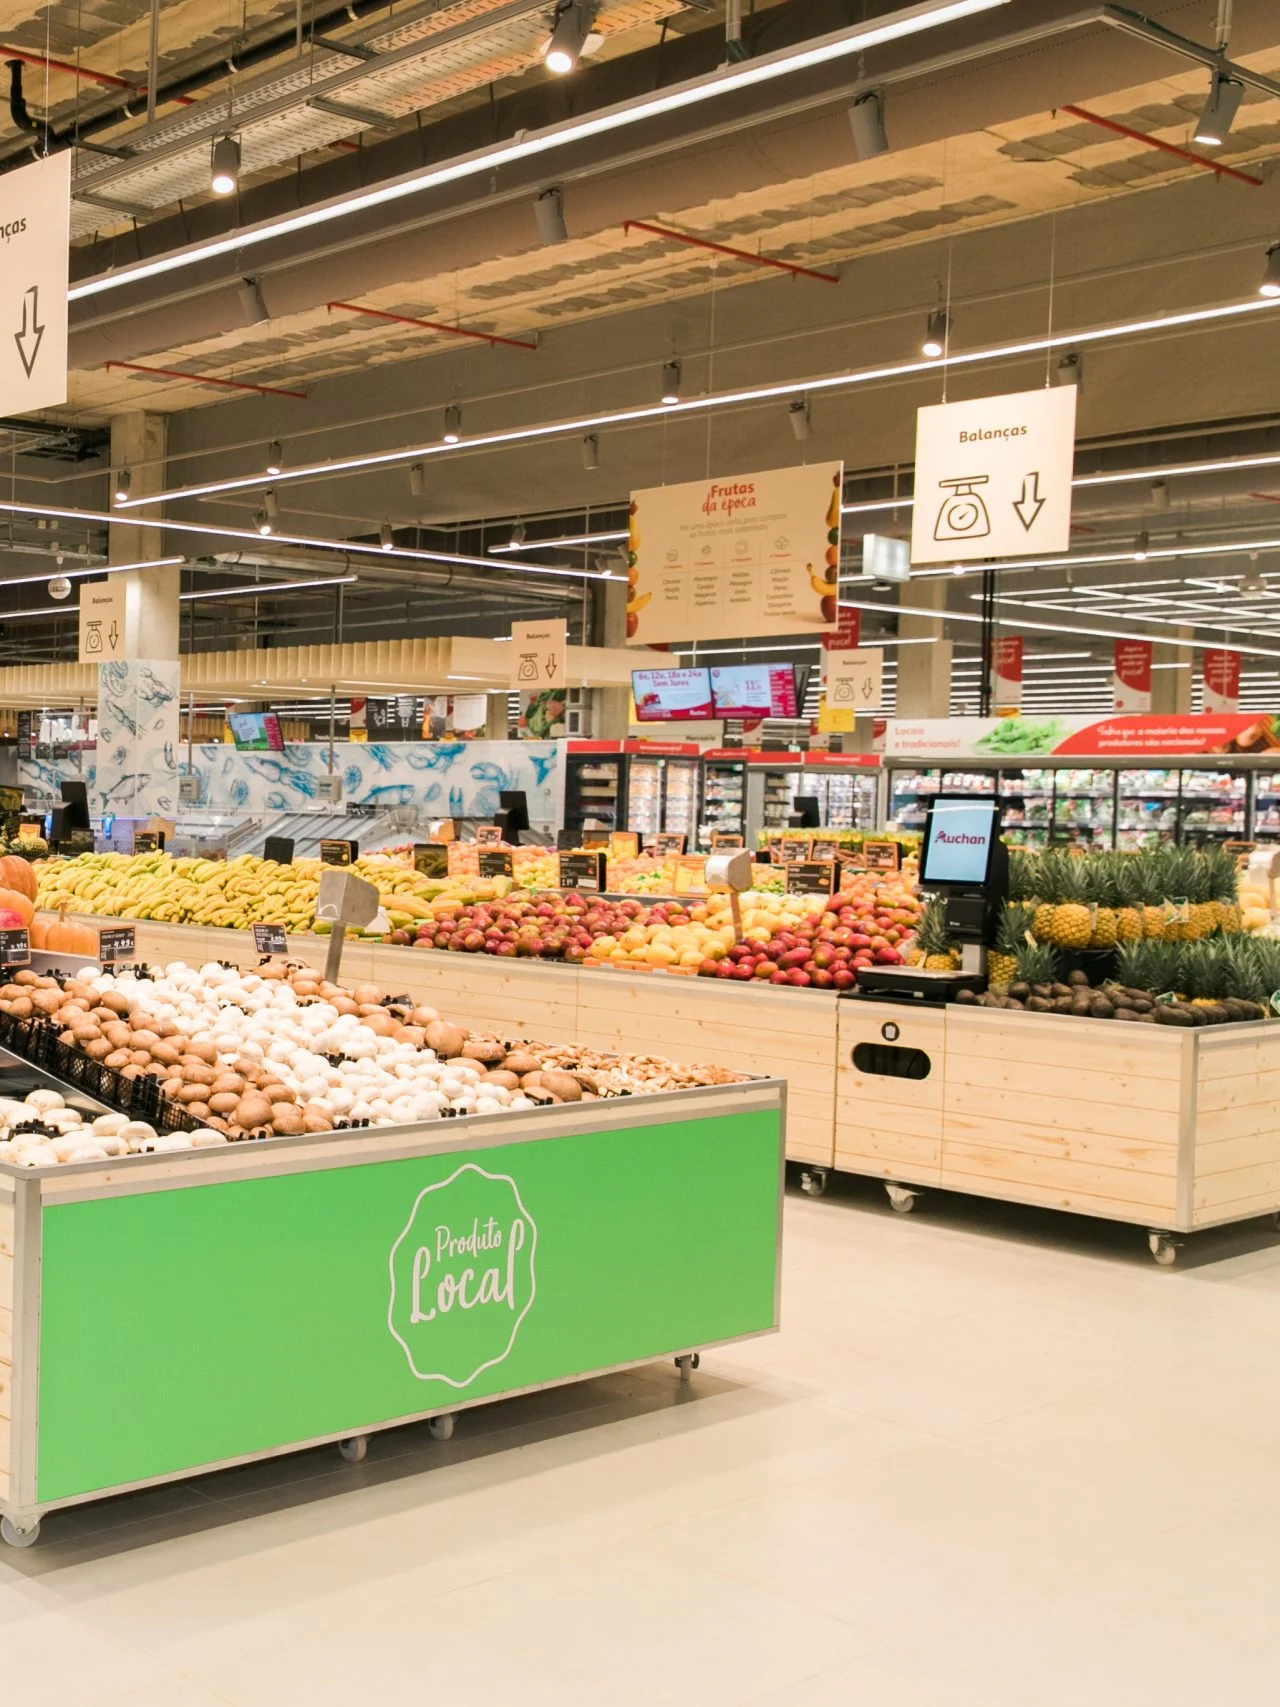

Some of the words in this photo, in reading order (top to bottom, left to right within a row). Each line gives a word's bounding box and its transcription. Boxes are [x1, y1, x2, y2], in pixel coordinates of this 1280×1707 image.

[959, 425, 1028, 443] Balanças
[711, 483, 755, 498] Frutas
[702, 492, 718, 516] da
[721, 496, 757, 517] época
[895, 727, 924, 736] Locais
[901, 739, 961, 749] tradicionais!
[935, 830, 986, 845] Auchan
[434, 1216, 502, 1263] Produto
[410, 1218, 525, 1324] Local
